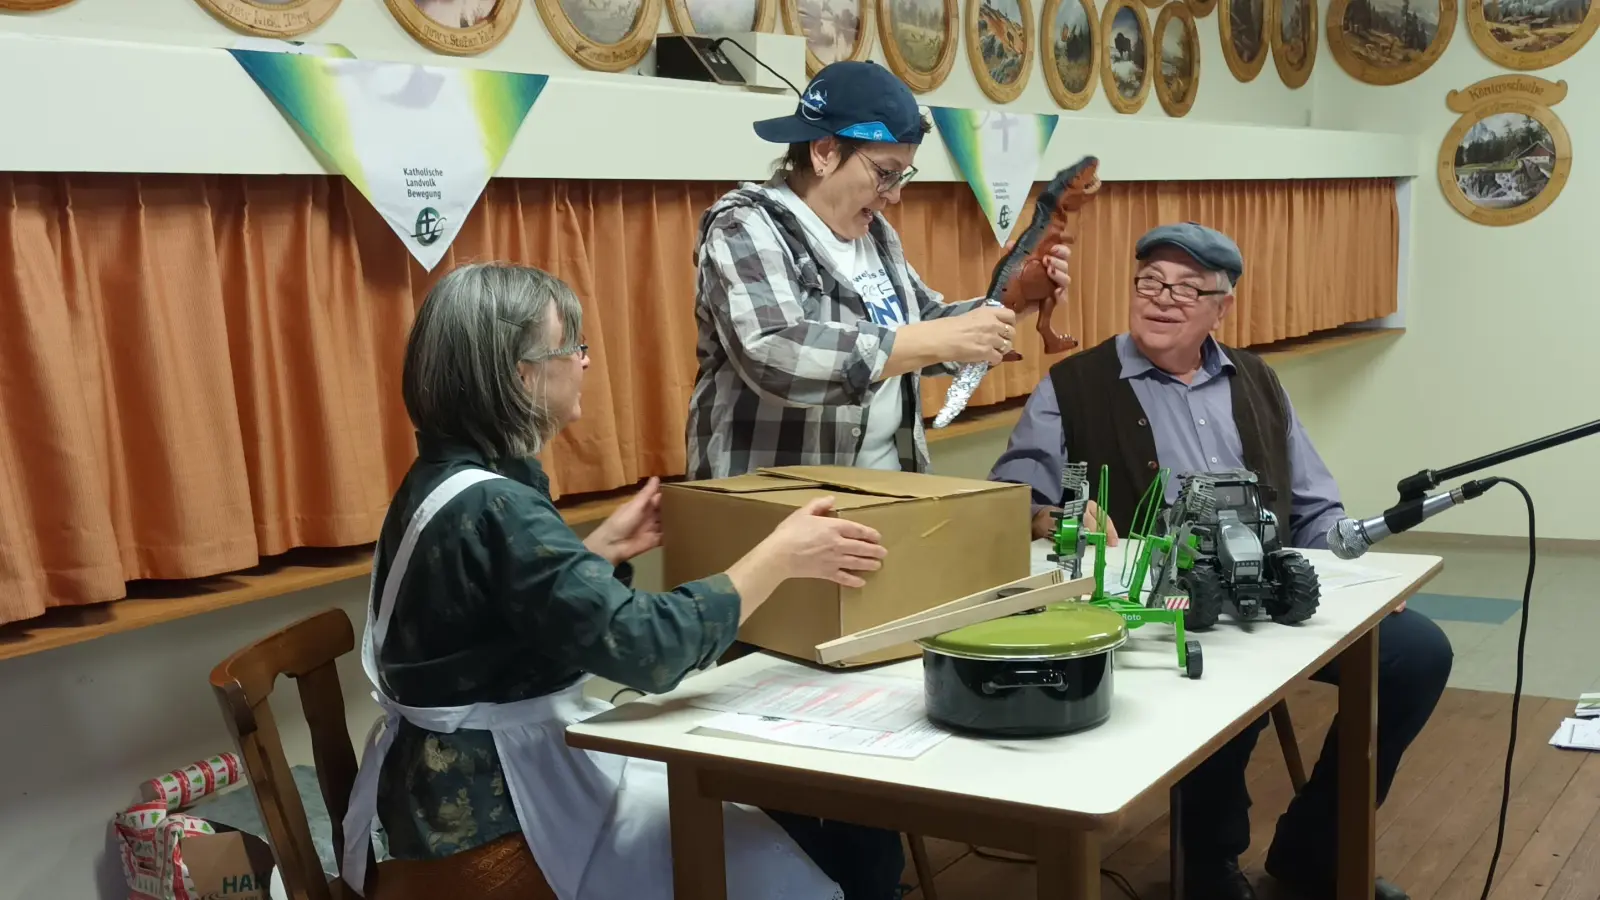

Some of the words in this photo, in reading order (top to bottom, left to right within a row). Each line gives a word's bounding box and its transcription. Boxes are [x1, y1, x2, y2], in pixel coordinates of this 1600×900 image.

[403, 167, 444, 176] Katholische
[405, 178, 437, 187] Landvolk
[407, 188, 442, 200] Bewegung
